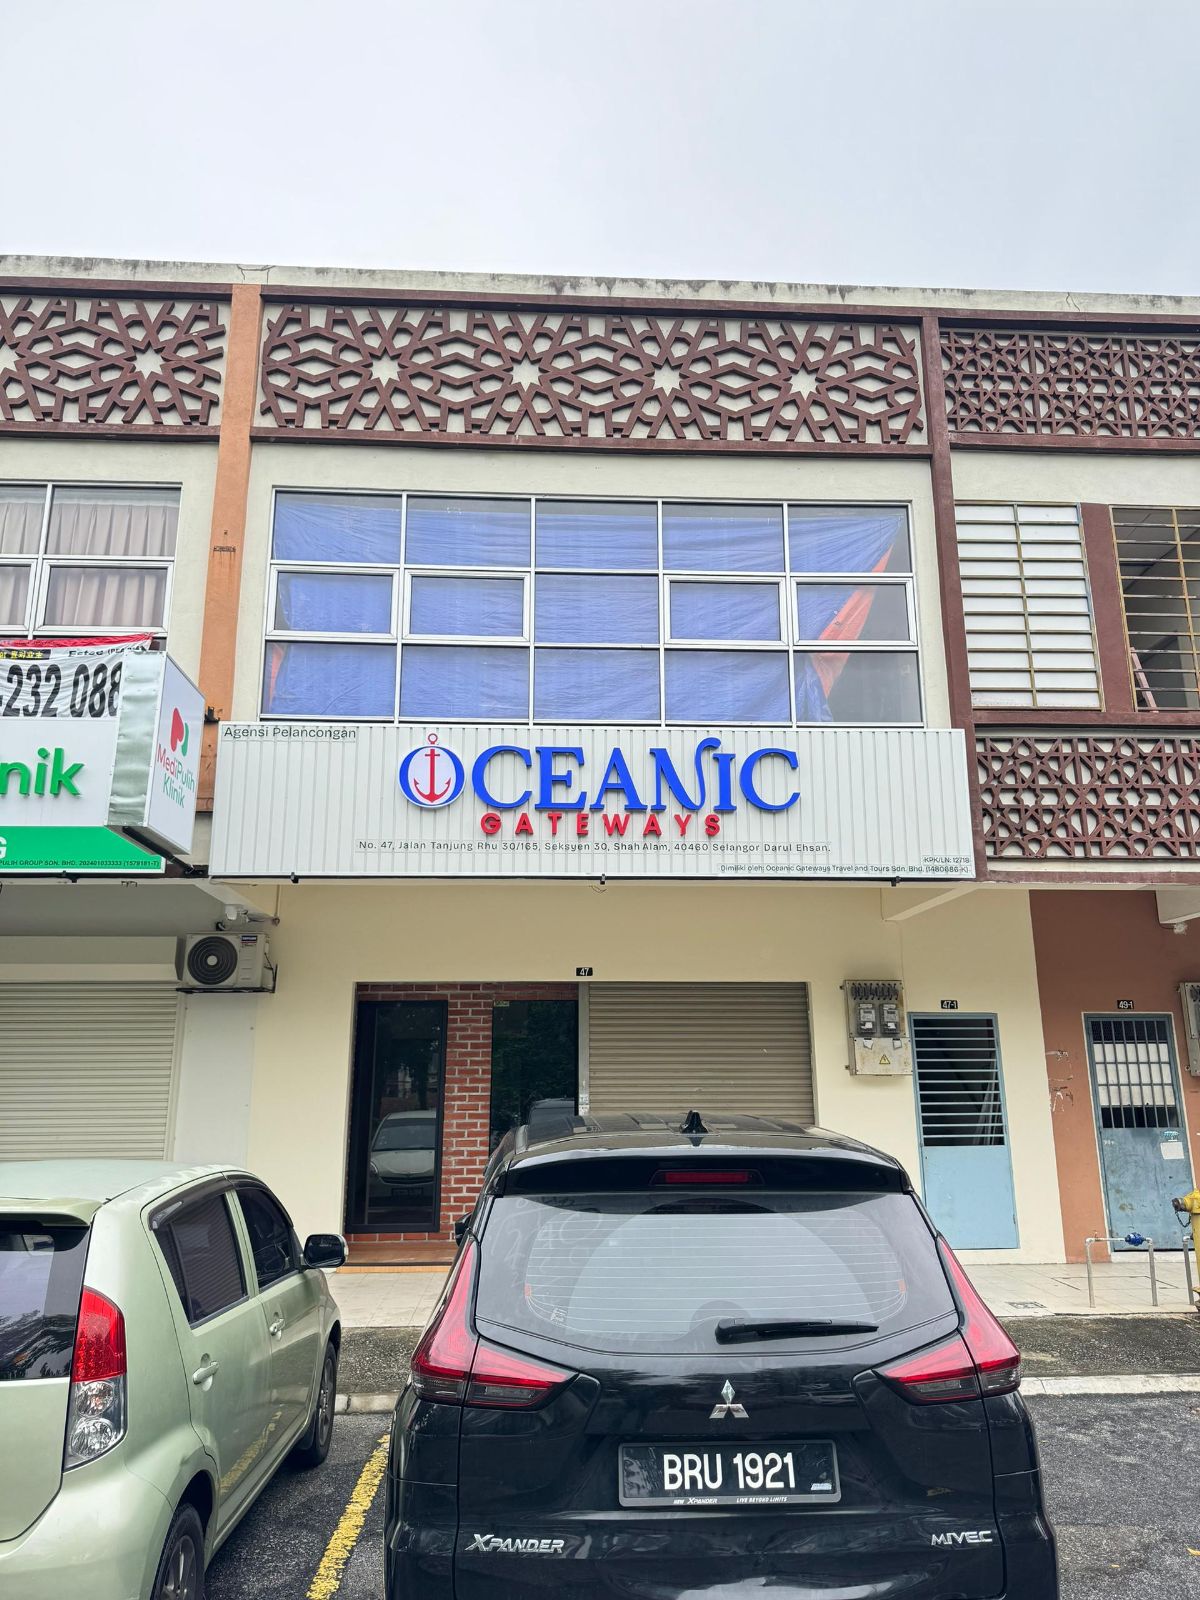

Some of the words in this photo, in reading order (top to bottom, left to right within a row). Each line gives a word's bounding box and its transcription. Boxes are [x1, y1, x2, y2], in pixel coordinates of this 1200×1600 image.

[224, 727, 270, 739] Agensi
[272, 726, 357, 740] Pelancongan
[157, 743, 195, 793] MediPulih
[399, 737, 801, 814] OCEANIC
[163, 773, 185, 809] Klinik
[480, 812, 721, 836] GATEWAYS
[359, 841, 377, 849] No.
[380, 841, 395, 850] 47,
[399, 841, 426, 850] Jalan
[431, 841, 473, 851] Tanjung
[477, 841, 498, 850] Rhu
[502, 842, 541, 851] 30/165,
[544, 842, 591, 852] Seksyen
[594, 842, 610, 852] 30,
[613, 842, 640, 851] Shah
[642, 842, 671, 852] Alam,
[674, 843, 709, 851] 40460
[712, 843, 760, 853] Selangor
[764, 843, 792, 852] Darul
[796, 843, 831, 852] Ehsan.
[765, 864, 794, 872] Oceanic
[795, 864, 831, 873] Gateways
[891, 865, 907, 873] Sdn.
[908, 865, 925, 873] Bhd.
[580, 967, 589, 976] 47
[943, 1000, 956, 1008] 47-1
[1119, 1000, 1133, 1008] 49-1
[663, 1453, 723, 1490] BRU
[732, 1452, 796, 1489] 1921
[464, 1533, 565, 1554] XPANDER
[930, 1530, 993, 1546] MIVEC
